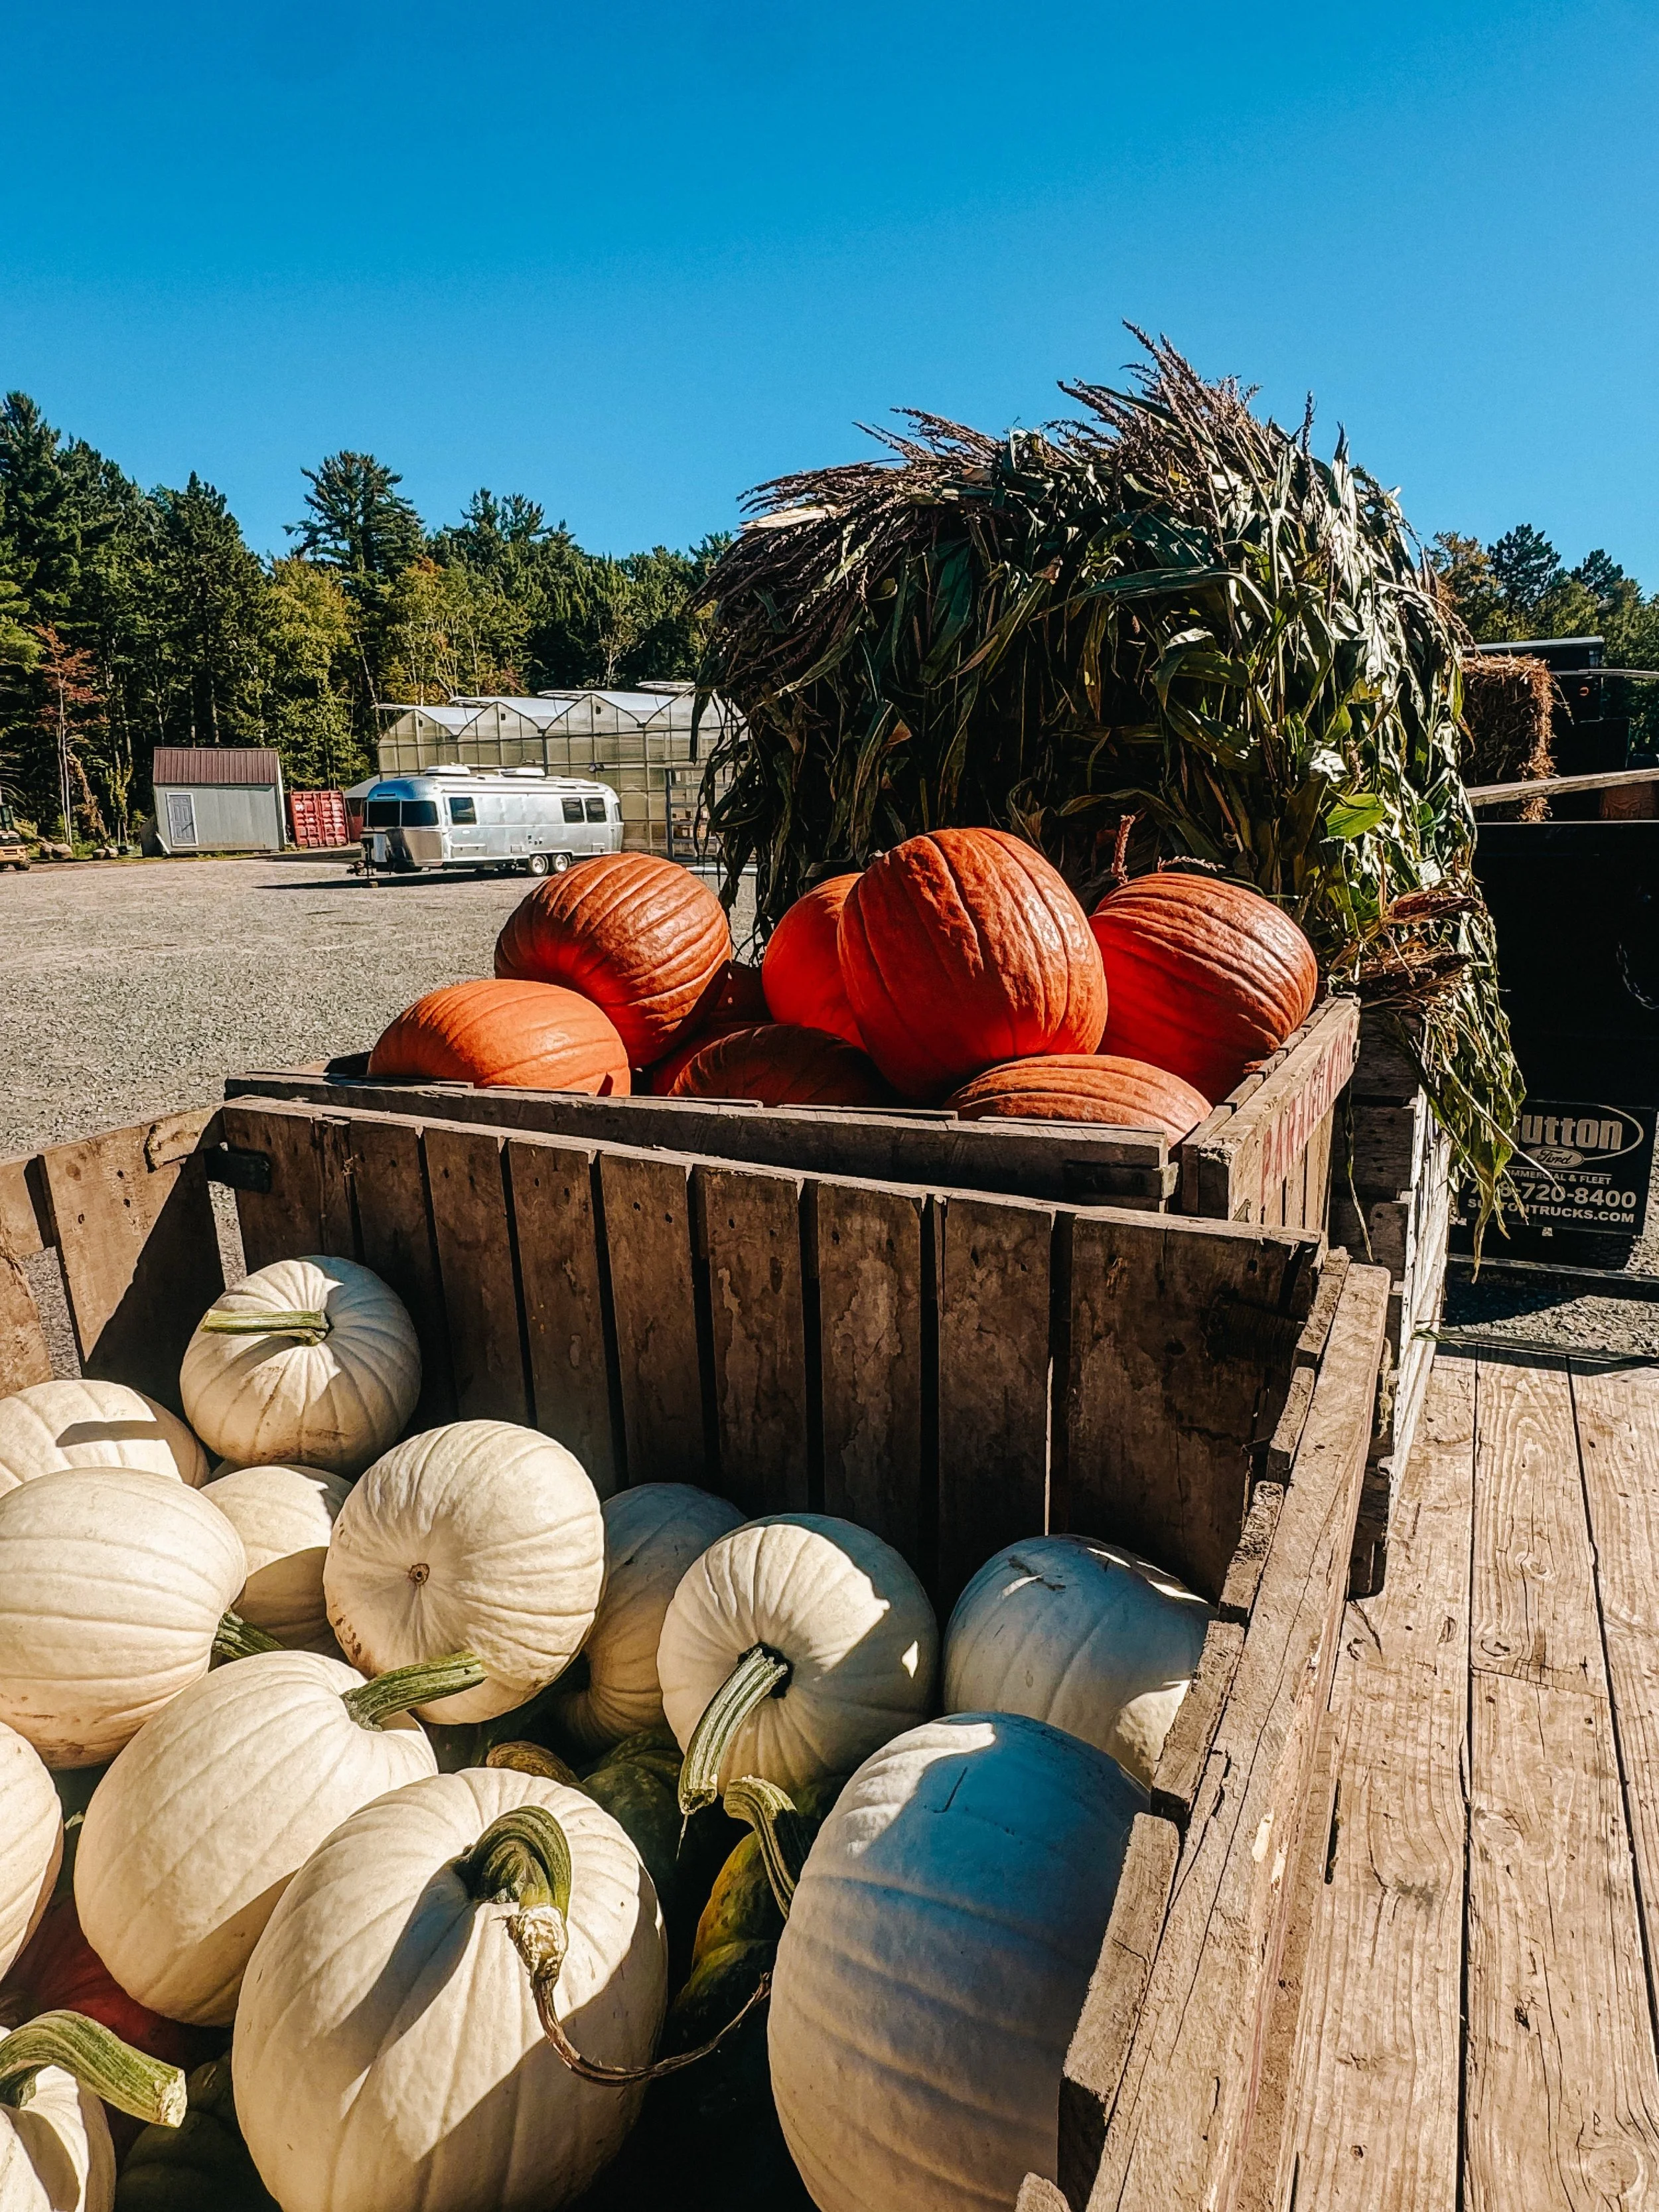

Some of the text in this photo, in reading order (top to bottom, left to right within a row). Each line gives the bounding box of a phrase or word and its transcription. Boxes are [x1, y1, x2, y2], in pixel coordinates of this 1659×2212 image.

[1510, 1114, 1623, 1150] utton
[1536, 1149, 1573, 1165] Ford
[1579, 1175, 1612, 1185] FLEET
[1469, 1177, 1637, 1209] 78-720-8400
